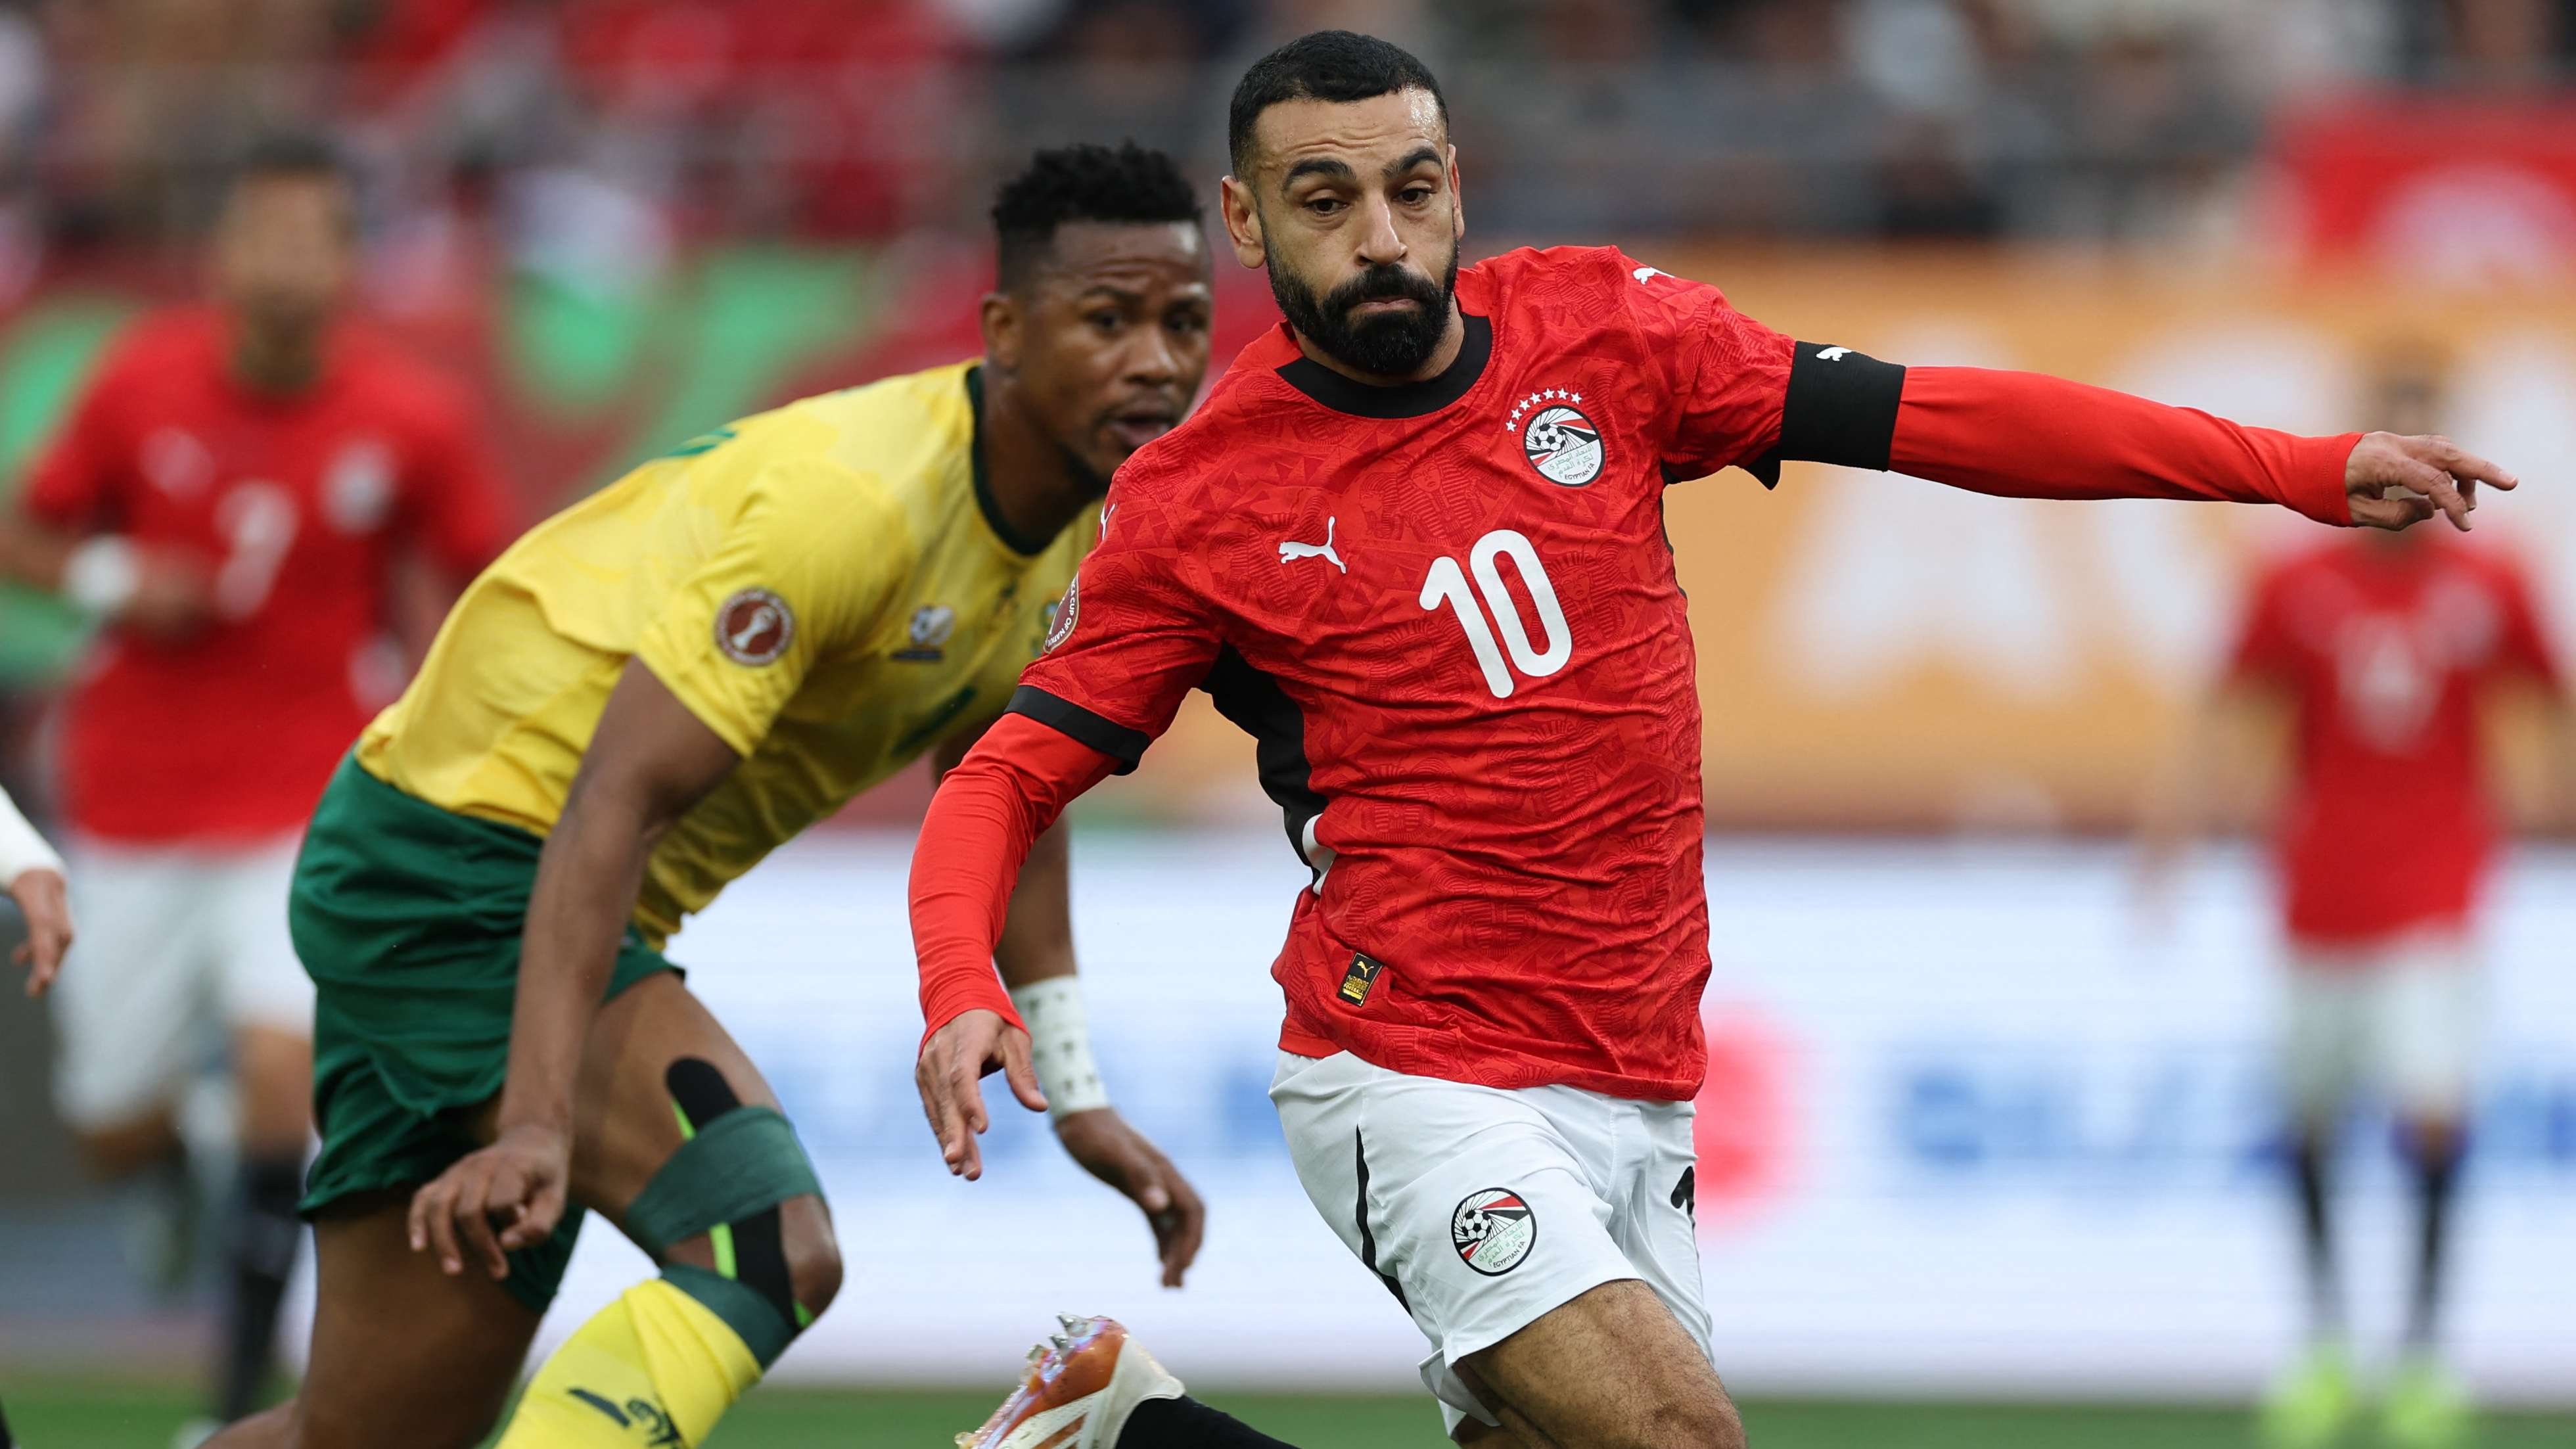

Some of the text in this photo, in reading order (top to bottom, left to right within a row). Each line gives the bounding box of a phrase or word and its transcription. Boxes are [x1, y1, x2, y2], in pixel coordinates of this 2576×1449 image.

[1565, 468, 1590, 479] EGYPTIAN
[1419, 529, 1573, 699] 10
[1064, 617, 1072, 630] OF
[1493, 1249, 1520, 1268] EGYPTIAN
